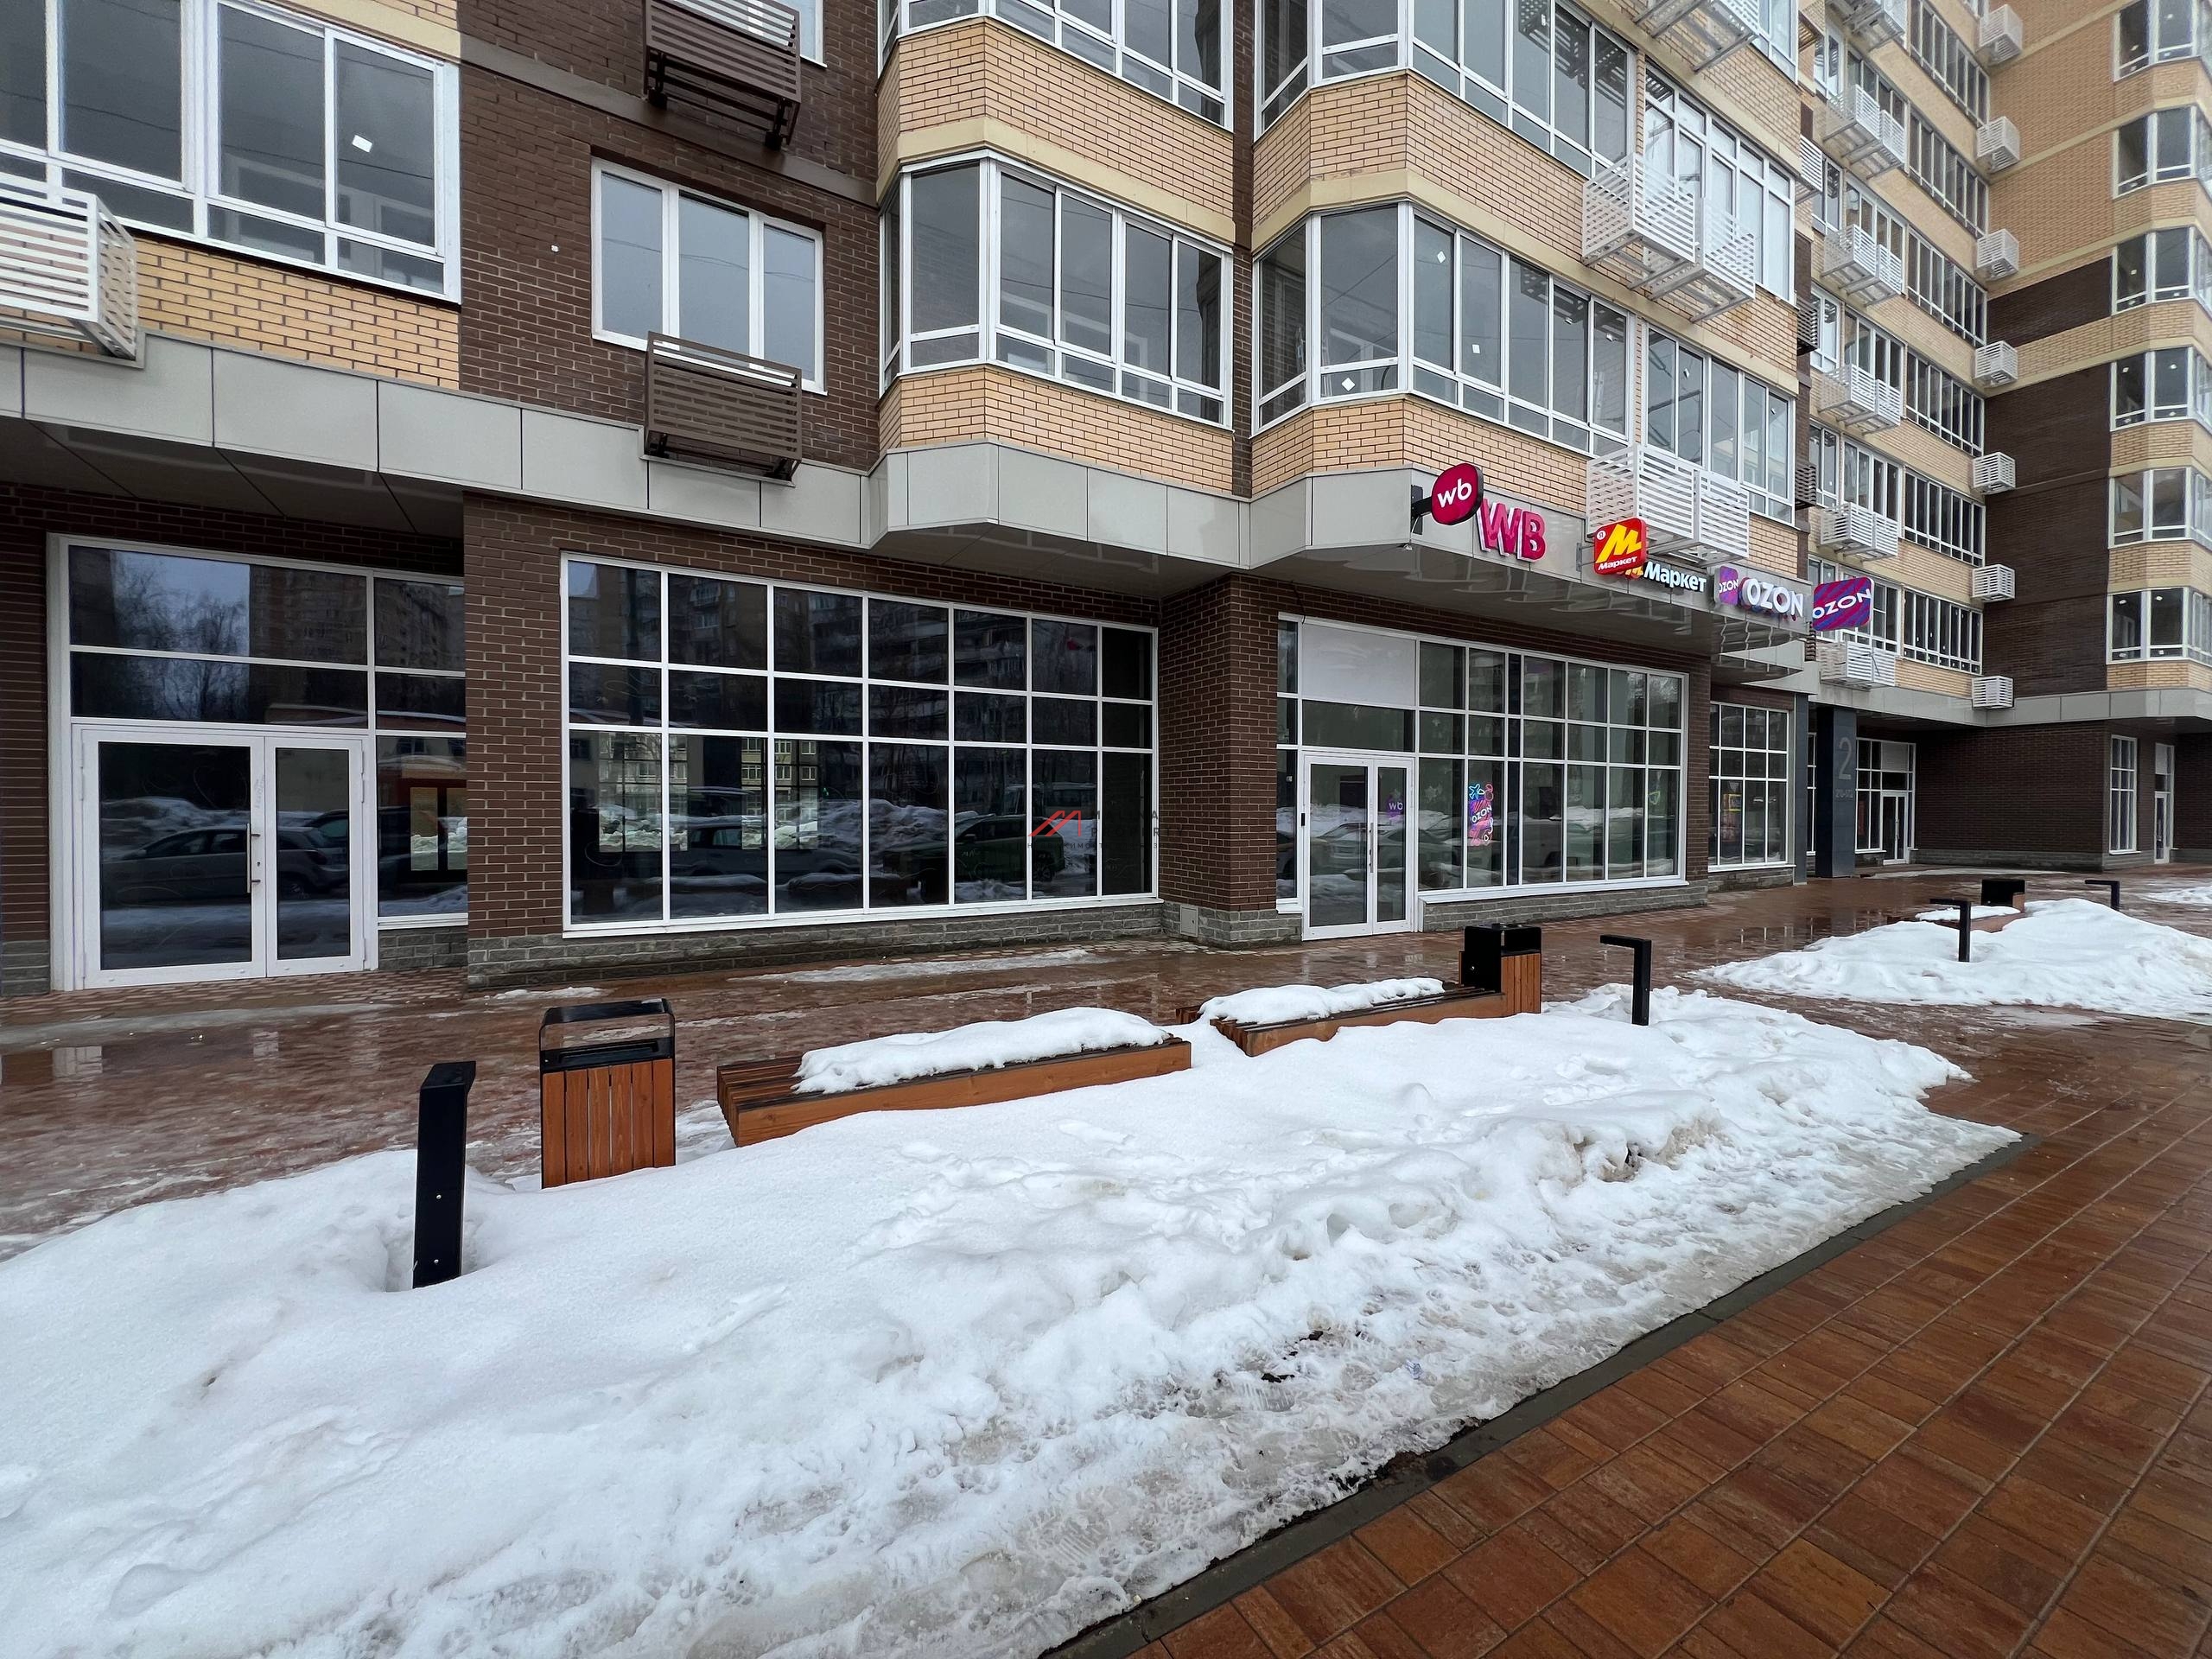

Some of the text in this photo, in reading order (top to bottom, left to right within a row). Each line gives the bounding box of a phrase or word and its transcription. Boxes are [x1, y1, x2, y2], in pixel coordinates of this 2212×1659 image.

[1437, 478, 1472, 508] wb
[1477, 499, 1546, 562] WB
[1598, 556, 1637, 570] Маркет
[1643, 561, 1707, 592] Маркет
[1743, 578, 1803, 618] OZON
[1812, 588, 1872, 619] OZON
[1839, 737, 1852, 779] 2
[1472, 804, 1492, 823] OZON
